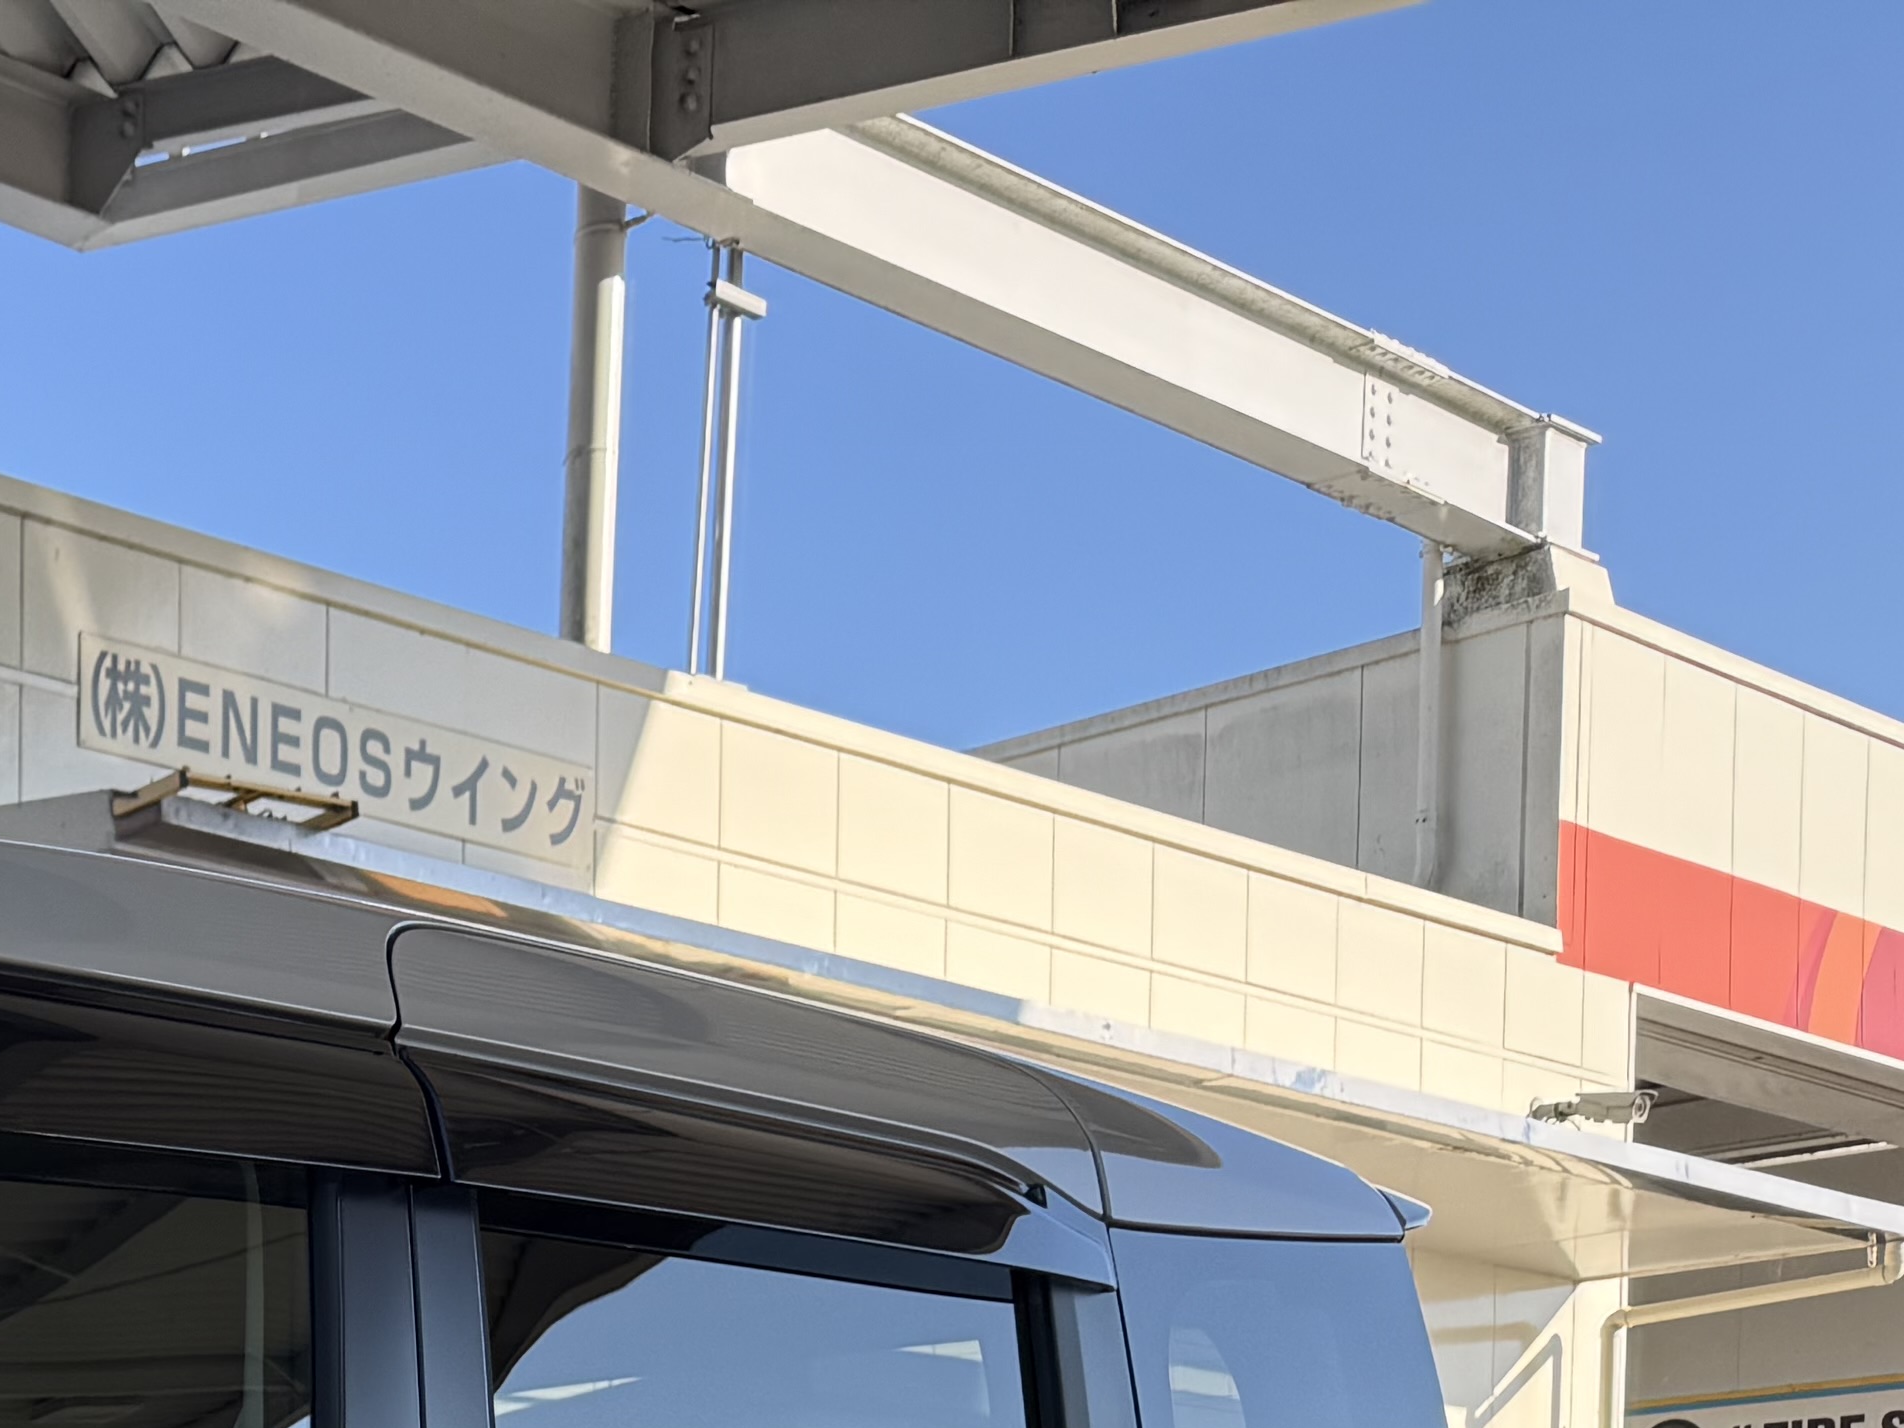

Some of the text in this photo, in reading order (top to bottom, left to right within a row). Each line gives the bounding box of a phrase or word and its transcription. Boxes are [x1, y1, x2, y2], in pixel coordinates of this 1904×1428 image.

[91, 650, 586, 847] (株)ENEOSウイング
